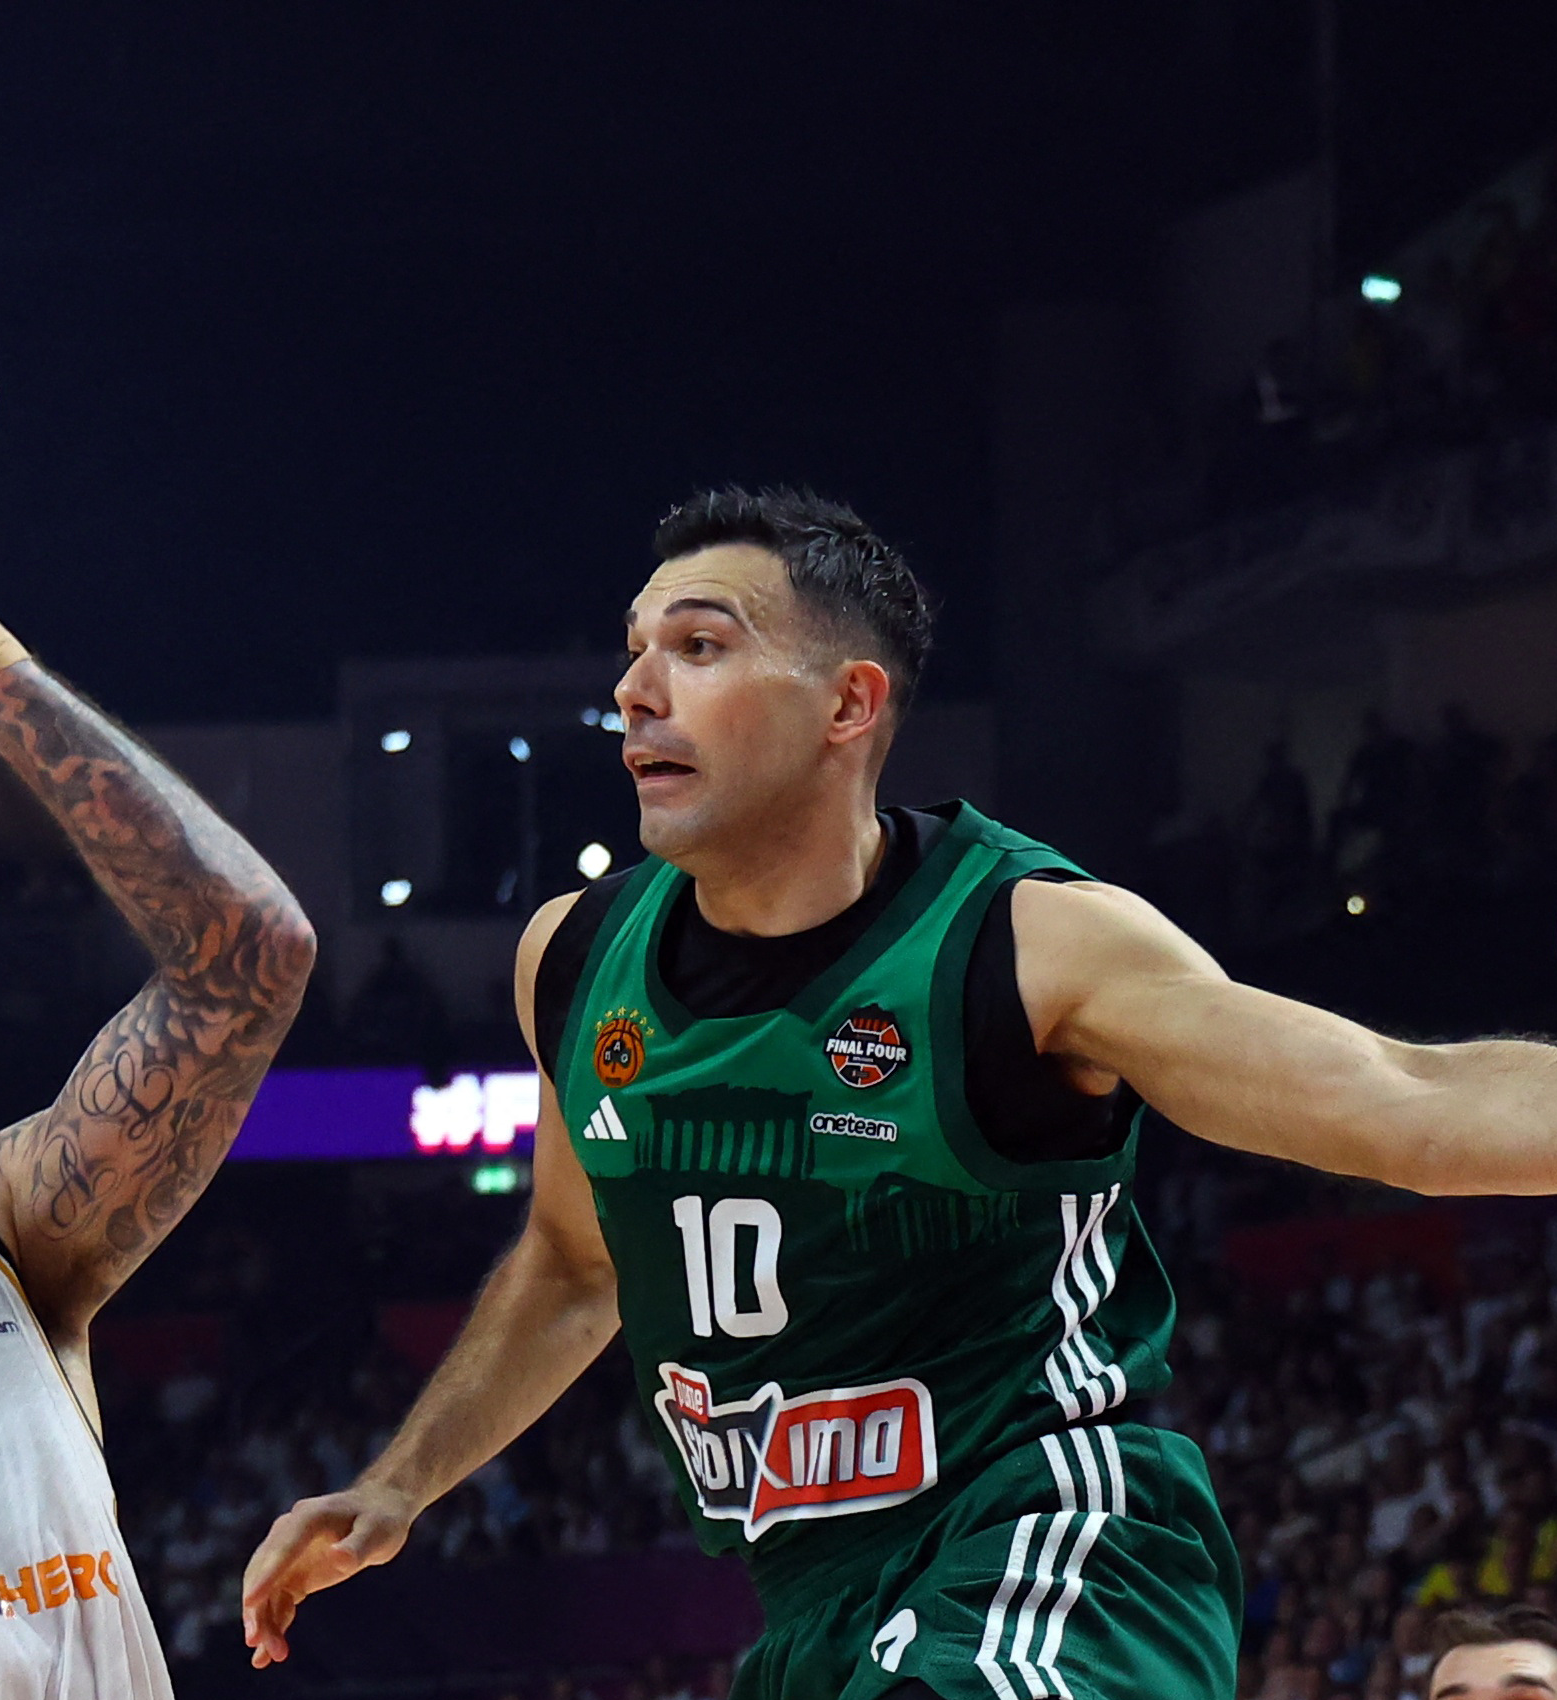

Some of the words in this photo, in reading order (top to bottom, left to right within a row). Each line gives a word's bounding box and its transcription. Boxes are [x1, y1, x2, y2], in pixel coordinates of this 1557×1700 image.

[826, 1038, 864, 1056] FINAL
[866, 1042, 907, 1062] FOUR
[811, 1113, 896, 1140] oneteam
[672, 1195, 788, 1338] 10
